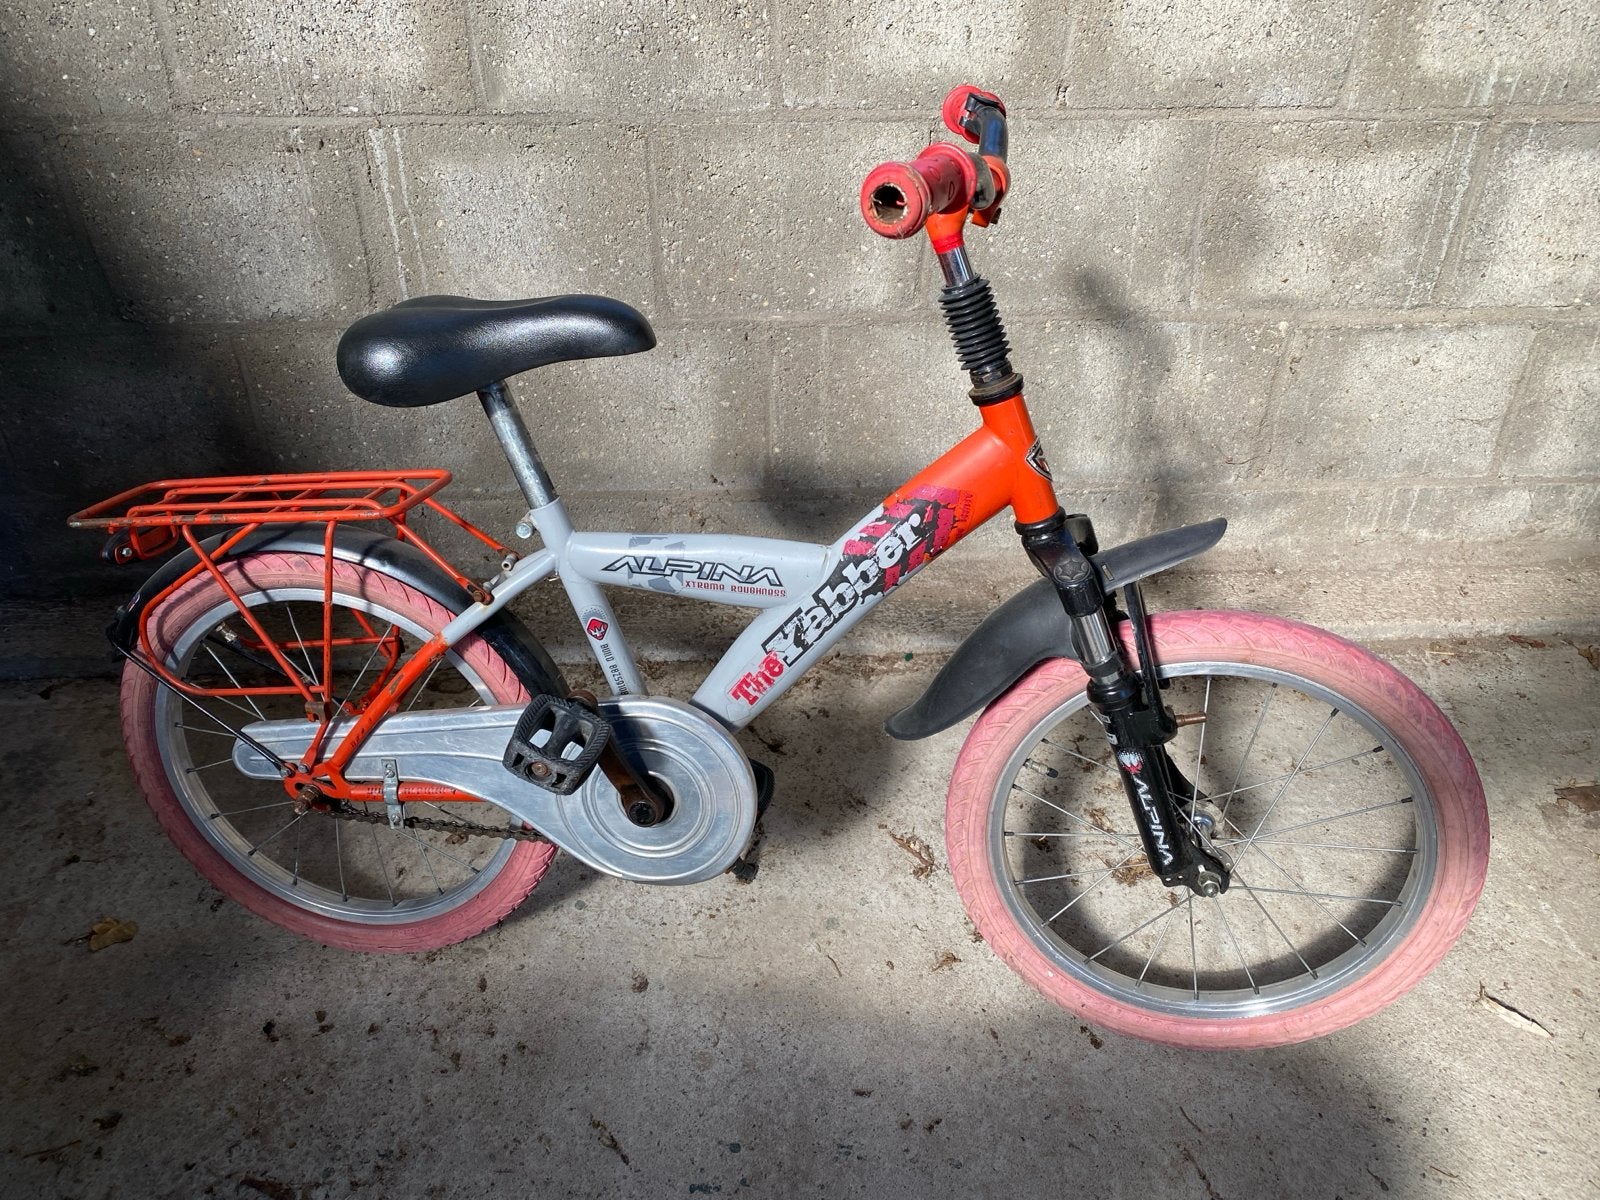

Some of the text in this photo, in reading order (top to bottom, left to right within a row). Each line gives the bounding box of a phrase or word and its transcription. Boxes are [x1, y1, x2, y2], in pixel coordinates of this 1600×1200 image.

[601, 555, 784, 587] ALPINA
[728, 512, 931, 706] The Yabber
[600, 643, 615, 662] BUILD
[1132, 774, 1174, 866] ALPINA
